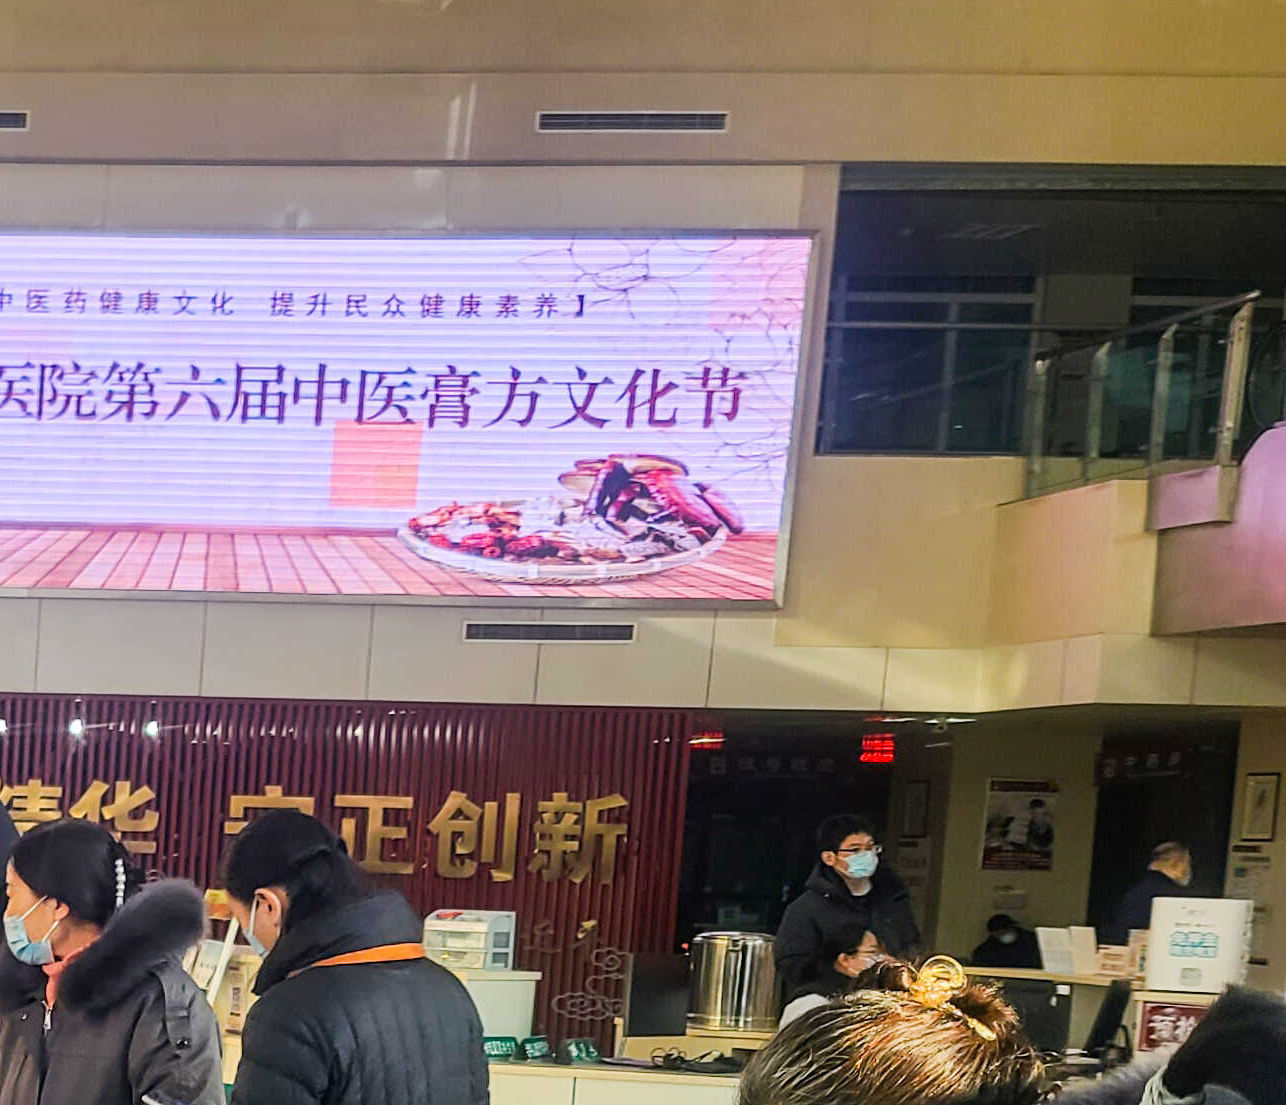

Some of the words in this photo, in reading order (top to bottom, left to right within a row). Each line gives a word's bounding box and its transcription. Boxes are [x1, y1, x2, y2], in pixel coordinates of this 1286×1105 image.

[270, 291, 586, 319] 提升民众健康素养】
